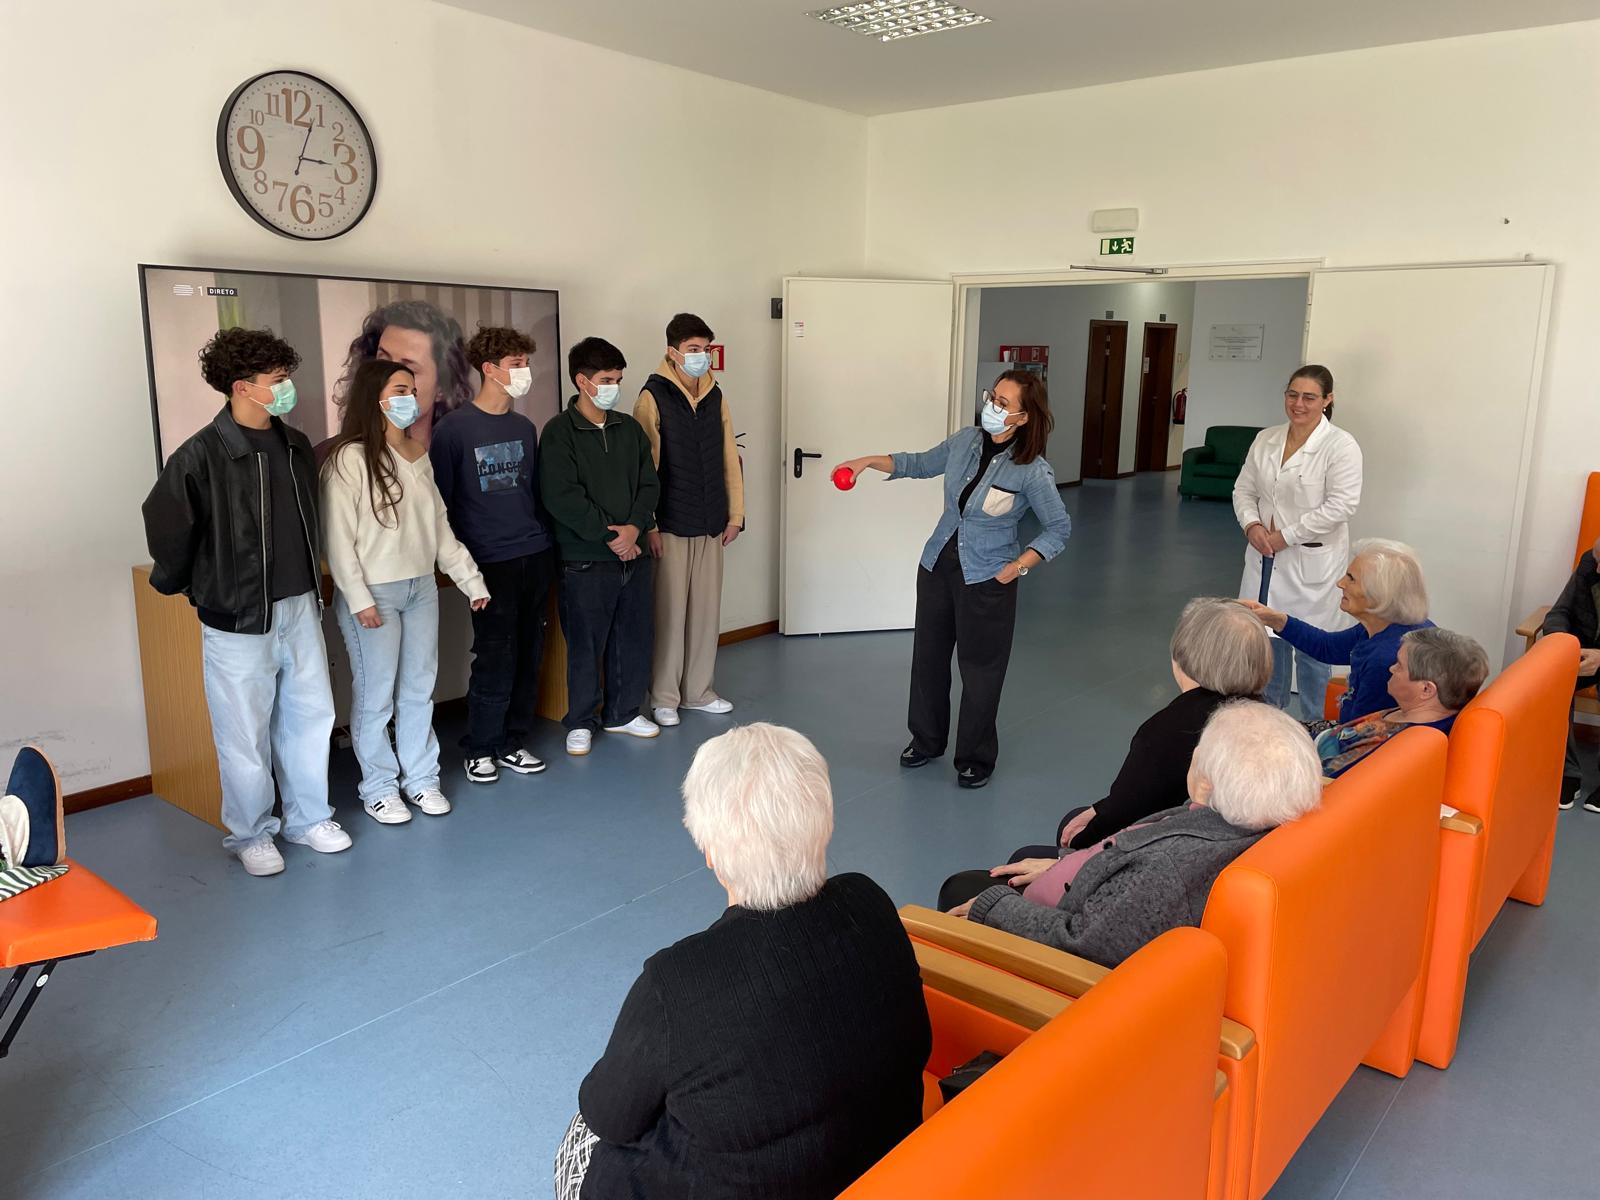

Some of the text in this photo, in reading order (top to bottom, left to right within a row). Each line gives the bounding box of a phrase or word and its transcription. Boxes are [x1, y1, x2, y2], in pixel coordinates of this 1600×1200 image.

[250, 108, 265, 126] 10
[264, 92, 282, 118] 11
[281, 88, 312, 128] 12
[315, 104, 326, 128] 1
[332, 122, 345, 142] 2
[236, 125, 266, 171] 9
[333, 143, 359, 185] 3
[253, 169, 268, 195] 8
[272, 181, 289, 212] 7
[289, 185, 316, 225] 6
[318, 192, 334, 218] 5
[334, 186, 347, 205] 4
